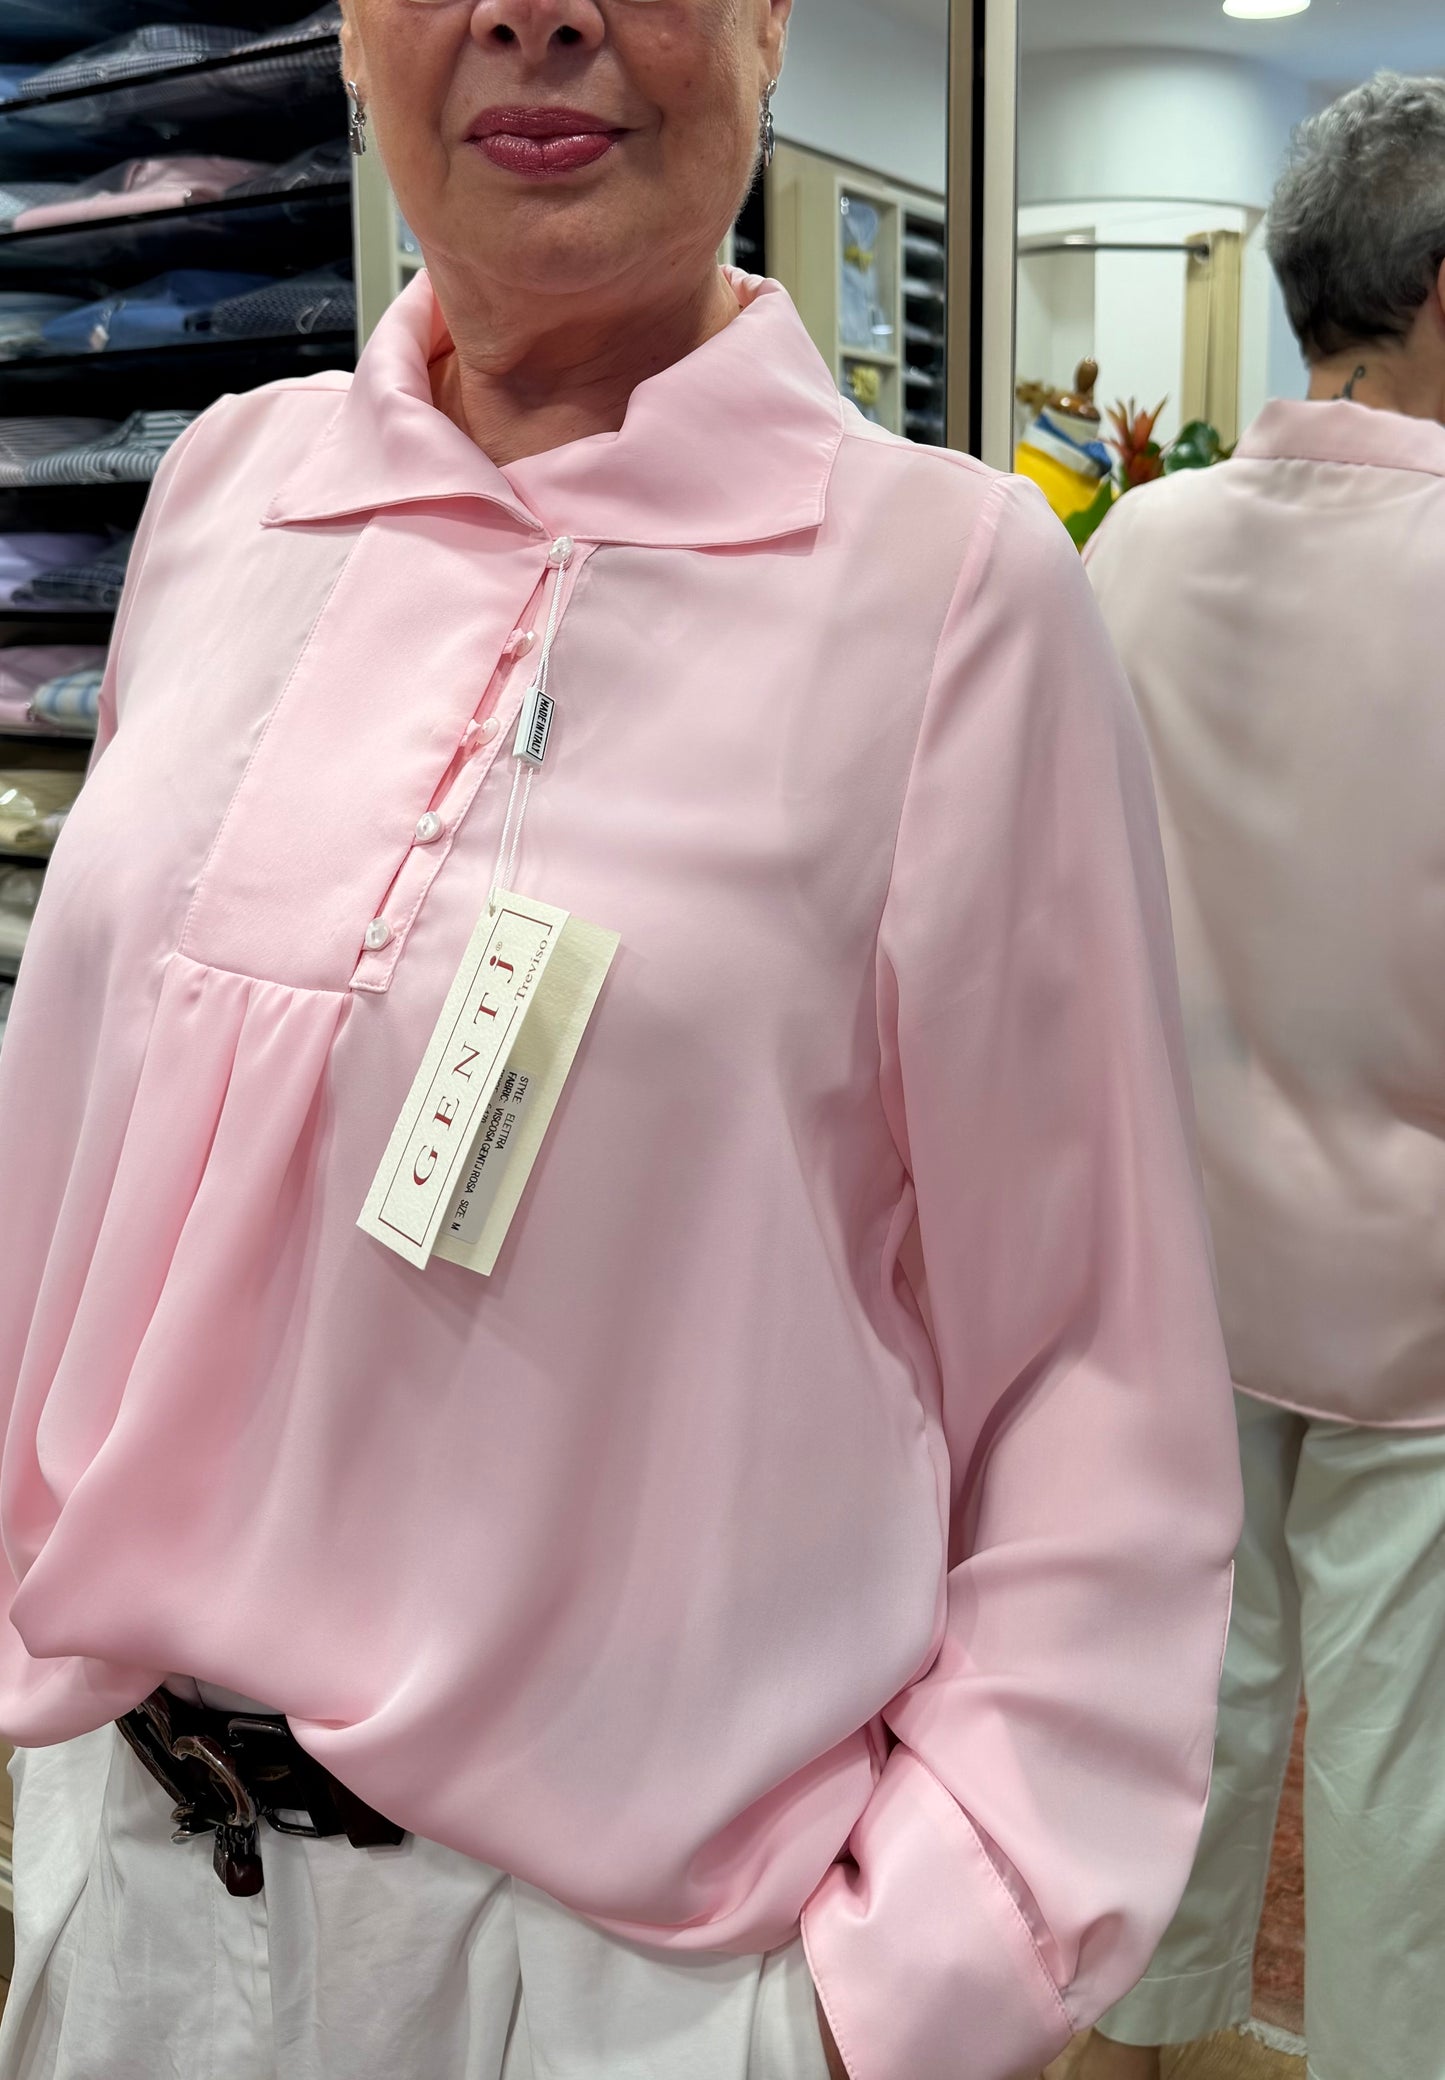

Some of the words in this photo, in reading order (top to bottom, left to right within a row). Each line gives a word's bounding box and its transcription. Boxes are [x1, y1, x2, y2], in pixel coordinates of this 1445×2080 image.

[537, 698, 550, 723] MADE
[535, 721, 545, 732] IN
[531, 730, 543, 754] ITALY
[514, 938, 549, 1003] Treviso
[486, 1107, 505, 1143] VISCOSA
[495, 1113, 516, 1150] ELETTRA
[464, 1169, 481, 1194] ROSA
[450, 1222, 461, 1231] M
